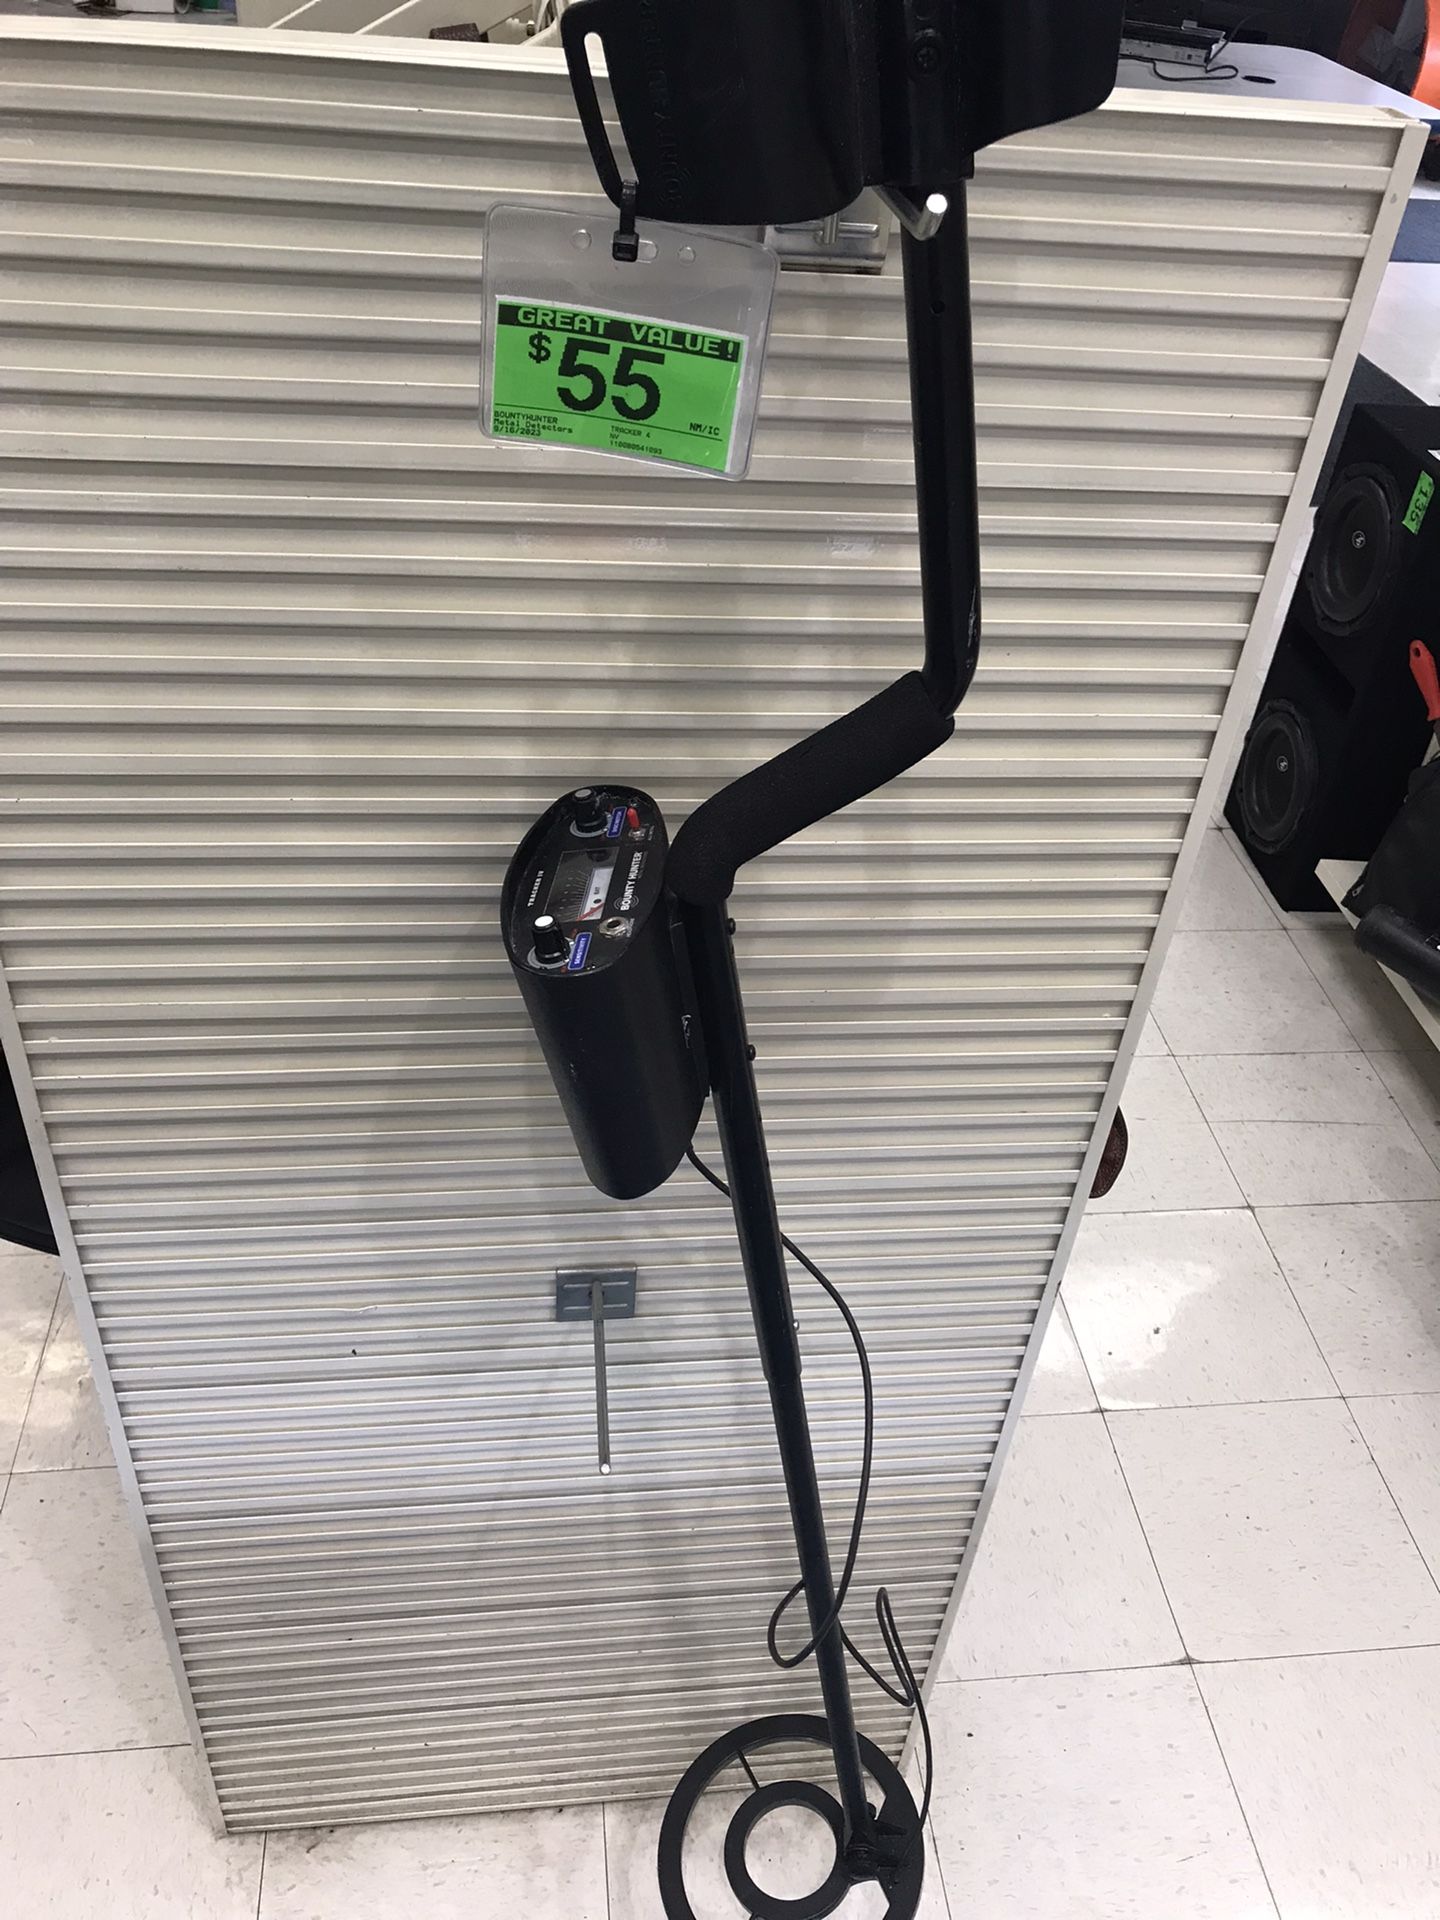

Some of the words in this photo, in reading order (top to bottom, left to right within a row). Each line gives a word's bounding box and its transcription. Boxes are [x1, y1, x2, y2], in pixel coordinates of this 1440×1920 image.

[517, 307, 610, 335] GREAT
[630, 323, 735, 359] VALUE!
[493, 410, 558, 424] BOUNTYHUNTER
[493, 418, 520, 427] Metal
[525, 421, 573, 434] Detectors
[610, 425, 642, 438] TRACKER
[689, 422, 720, 436] NM/IC
[620, 880, 636, 911] BOUNTY
[628, 851, 643, 880] HUNTER
[527, 877, 543, 908] TRACKER
